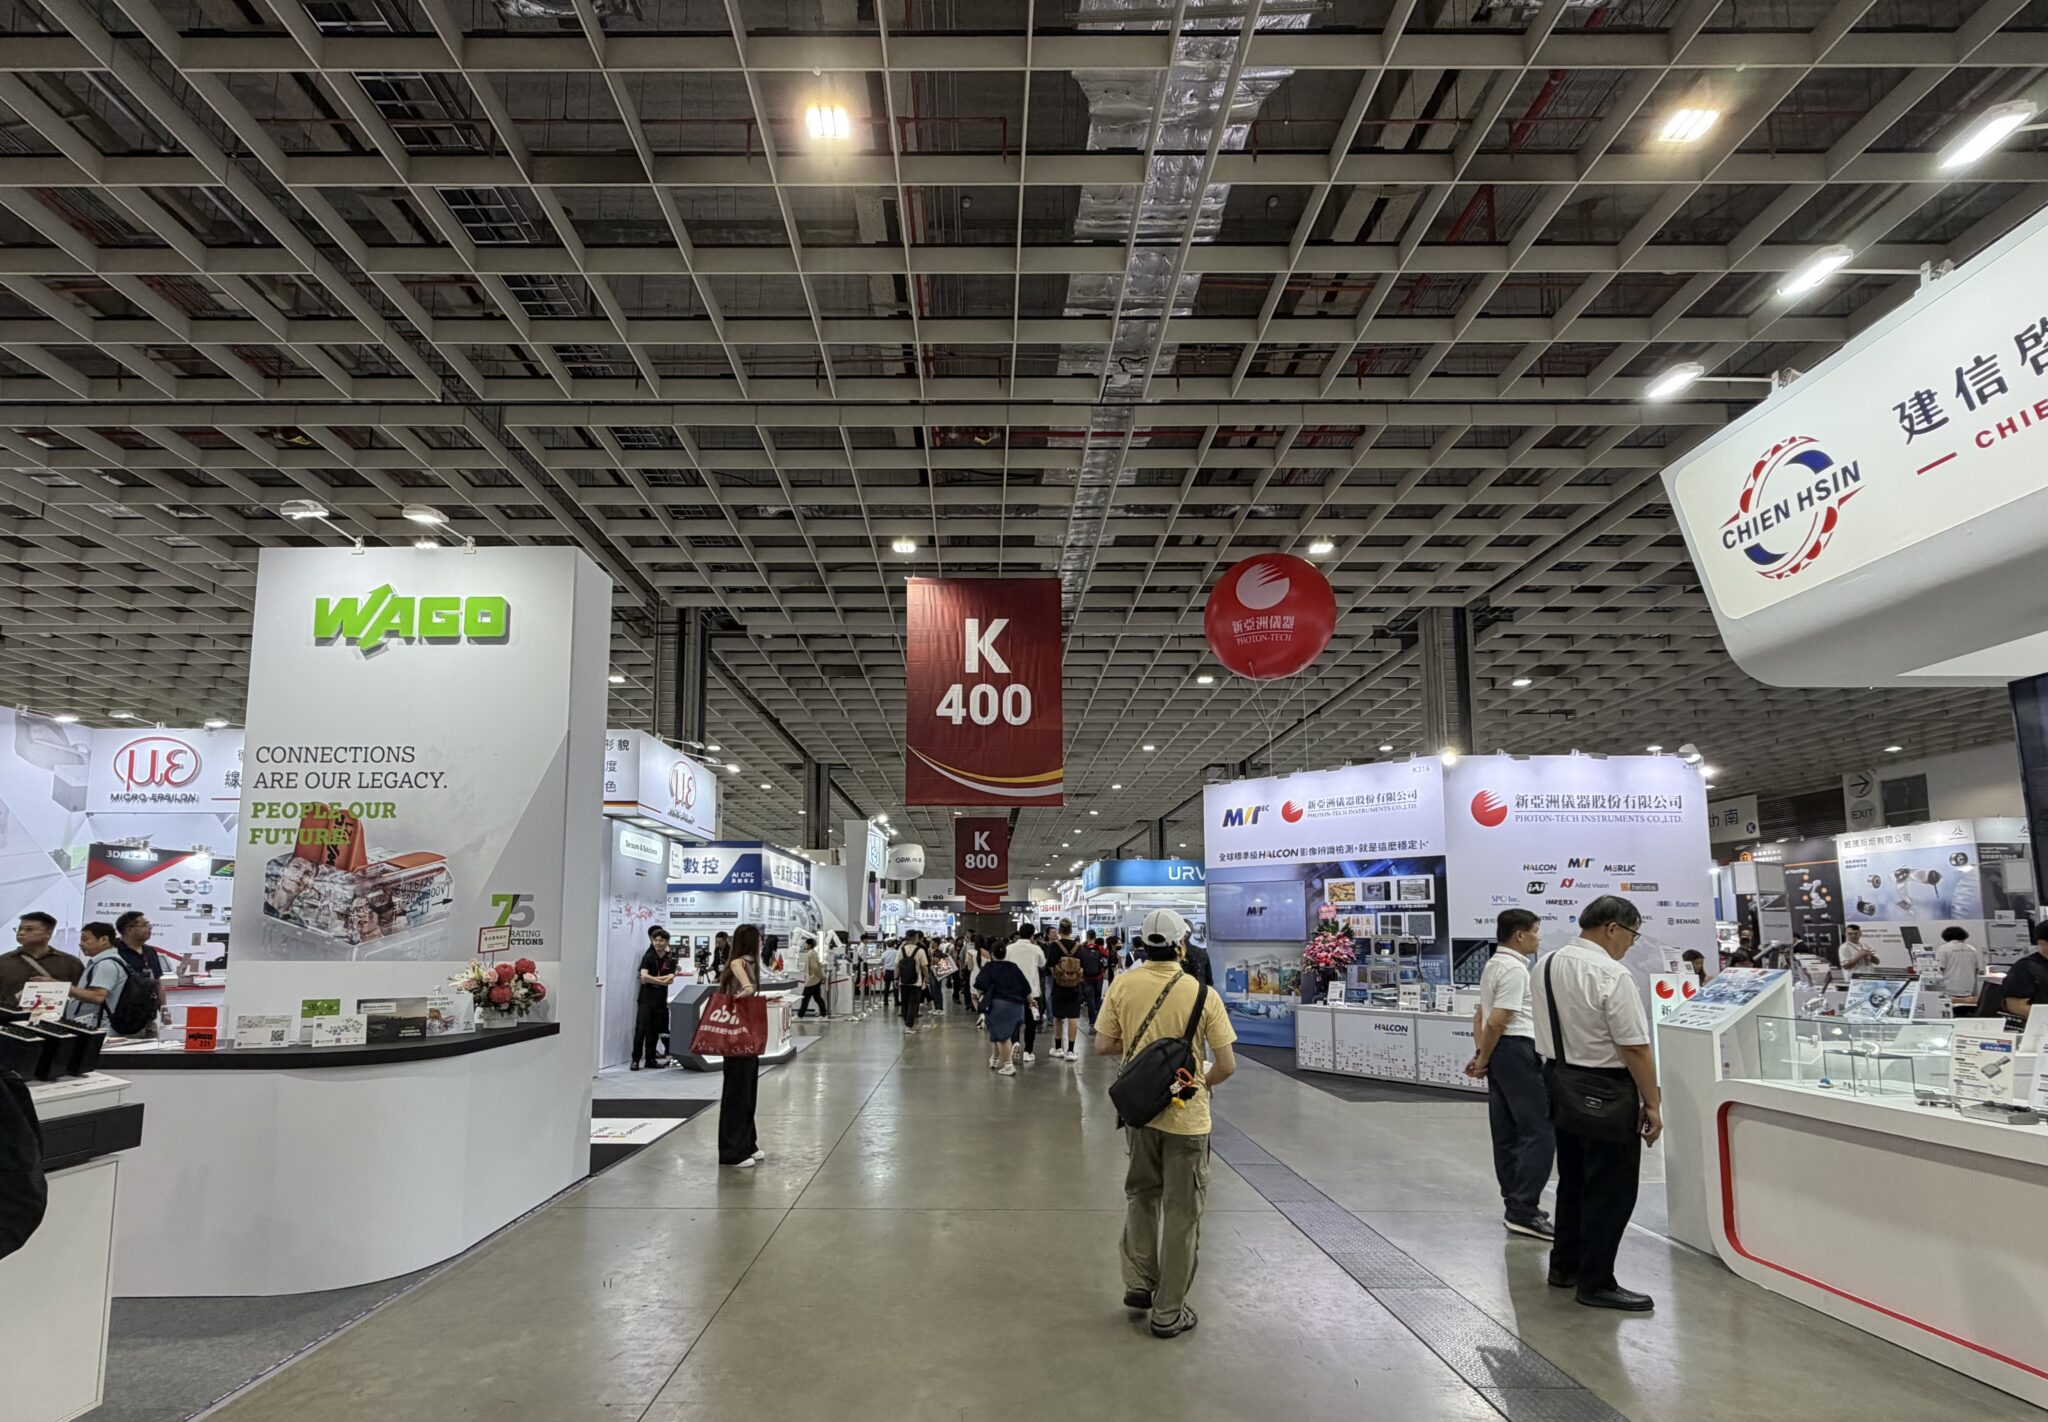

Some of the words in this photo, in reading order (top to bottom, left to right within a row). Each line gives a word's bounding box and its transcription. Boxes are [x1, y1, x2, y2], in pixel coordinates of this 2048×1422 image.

[1975, 398, 2048, 449] CHIE
[1722, 498, 1791, 550] CHIEN
[1798, 461, 1861, 514] HSIN
[314, 584, 511, 656] WAGO
[1232, 615, 1295, 633] 新亞洲儀器
[965, 618, 1012, 673] K
[1236, 634, 1291, 645] PHOTON-TECH
[935, 683, 1032, 726] 400
[255, 746, 416, 763] CONNECTIONS
[253, 771, 299, 789] ARE
[304, 771, 351, 789] OUR
[357, 771, 448, 789] LEGACY.
[1307, 789, 1417, 811] 新亞洲儀器股份有限公司
[1515, 794, 1682, 810] 新亞洲儀器股份有限公司
[251, 802, 343, 819] PEOPLE
[347, 802, 396, 819] OUR
[1307, 810, 1347, 819] PHOTON-TECH
[1348, 805, 1391, 815] INSTRUMENTS
[1515, 815, 1580, 823] PHOTON-TECH
[1582, 815, 1644, 823] INSTRUMENTS
[1723, 808, 1738, 826] 南
[1851, 808, 1873, 819] EXIT
[974, 831, 991, 851] K
[965, 853, 998, 869] 800
[1259, 849, 1298, 859] HALCON
[682, 857, 719, 874] 數控
[492, 894, 535, 928] 75
[511, 938, 544, 946] CTIONS
[1374, 1023, 1408, 1033] HALCON
